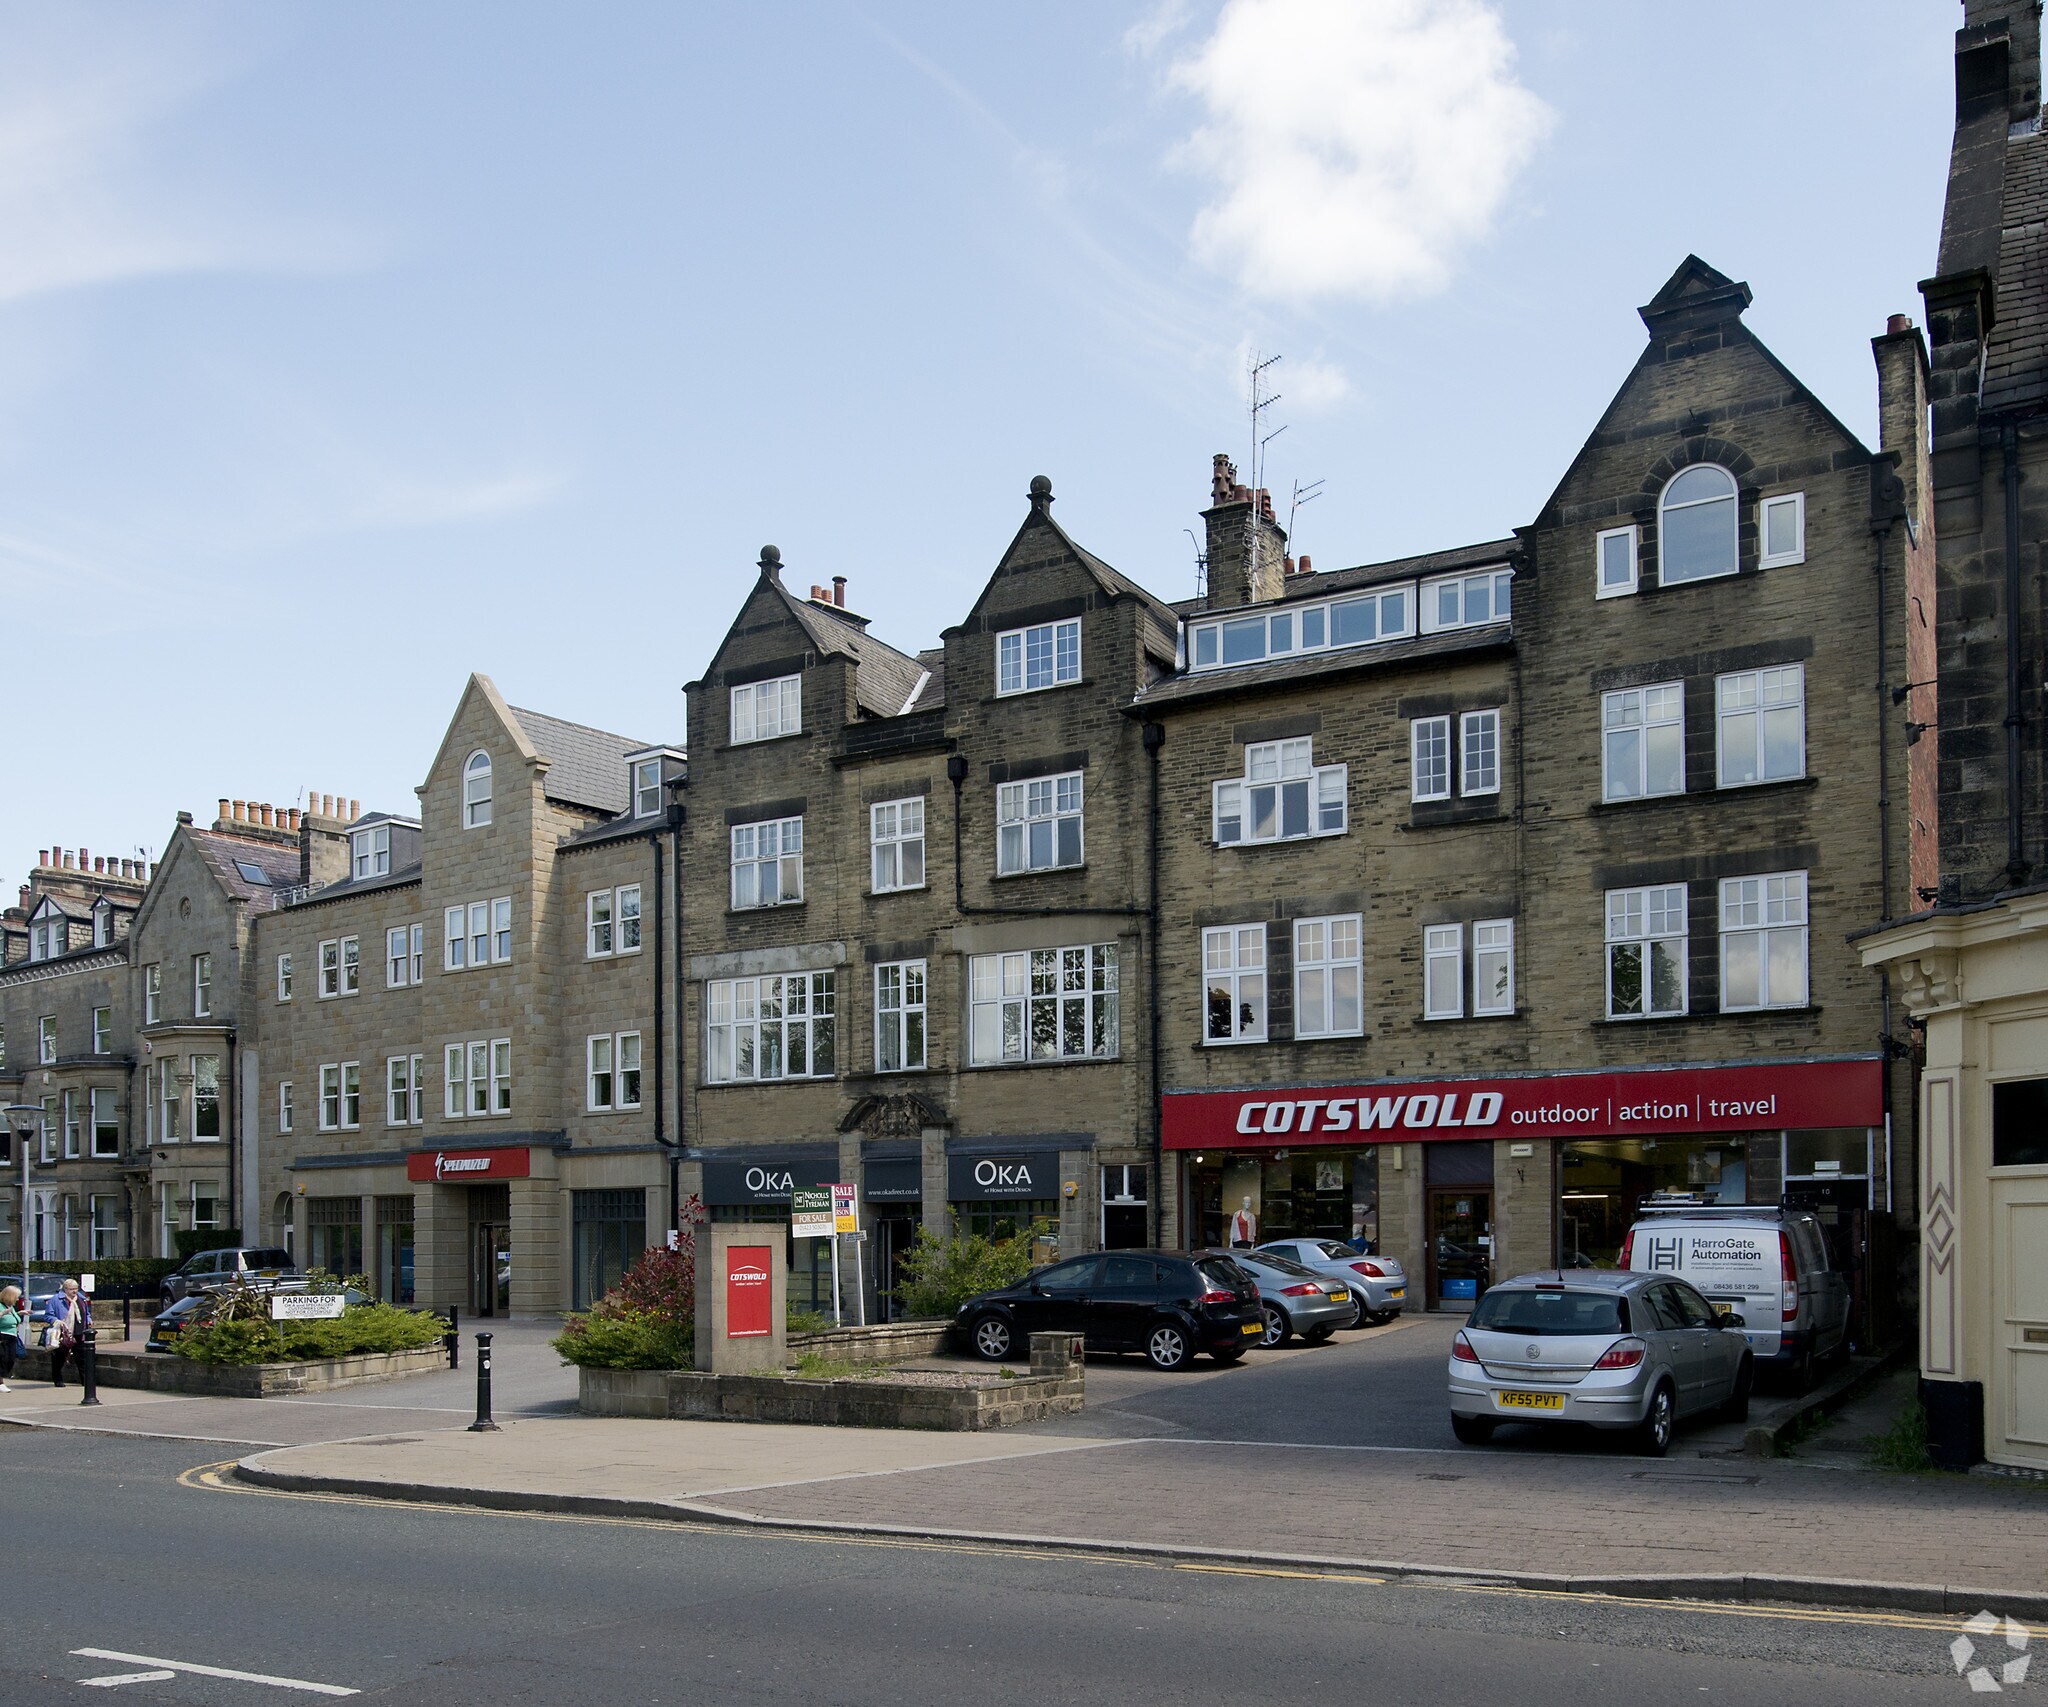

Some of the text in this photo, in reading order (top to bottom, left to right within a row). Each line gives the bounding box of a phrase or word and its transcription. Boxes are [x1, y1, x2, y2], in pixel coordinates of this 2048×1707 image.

[1236, 1092, 1504, 1134] COTSWOLD
[1510, 1094, 1776, 1124] outdoor action travel
[975, 1160, 1032, 1186] OKA
[746, 1167, 795, 1191] OKA
[804, 1191, 830, 1200] NICHOLLS
[835, 1186, 853, 1196] SALE
[805, 1200, 830, 1208] TYREMAN
[799, 1215, 811, 1223] FOR
[812, 1214, 827, 1222] SALE
[1692, 1238, 1754, 1248] HarroGate
[1691, 1250, 1761, 1260] Automation
[730, 1273, 767, 1281] COTSWOLD
[1502, 1392, 1558, 1406] KF55 PVT
